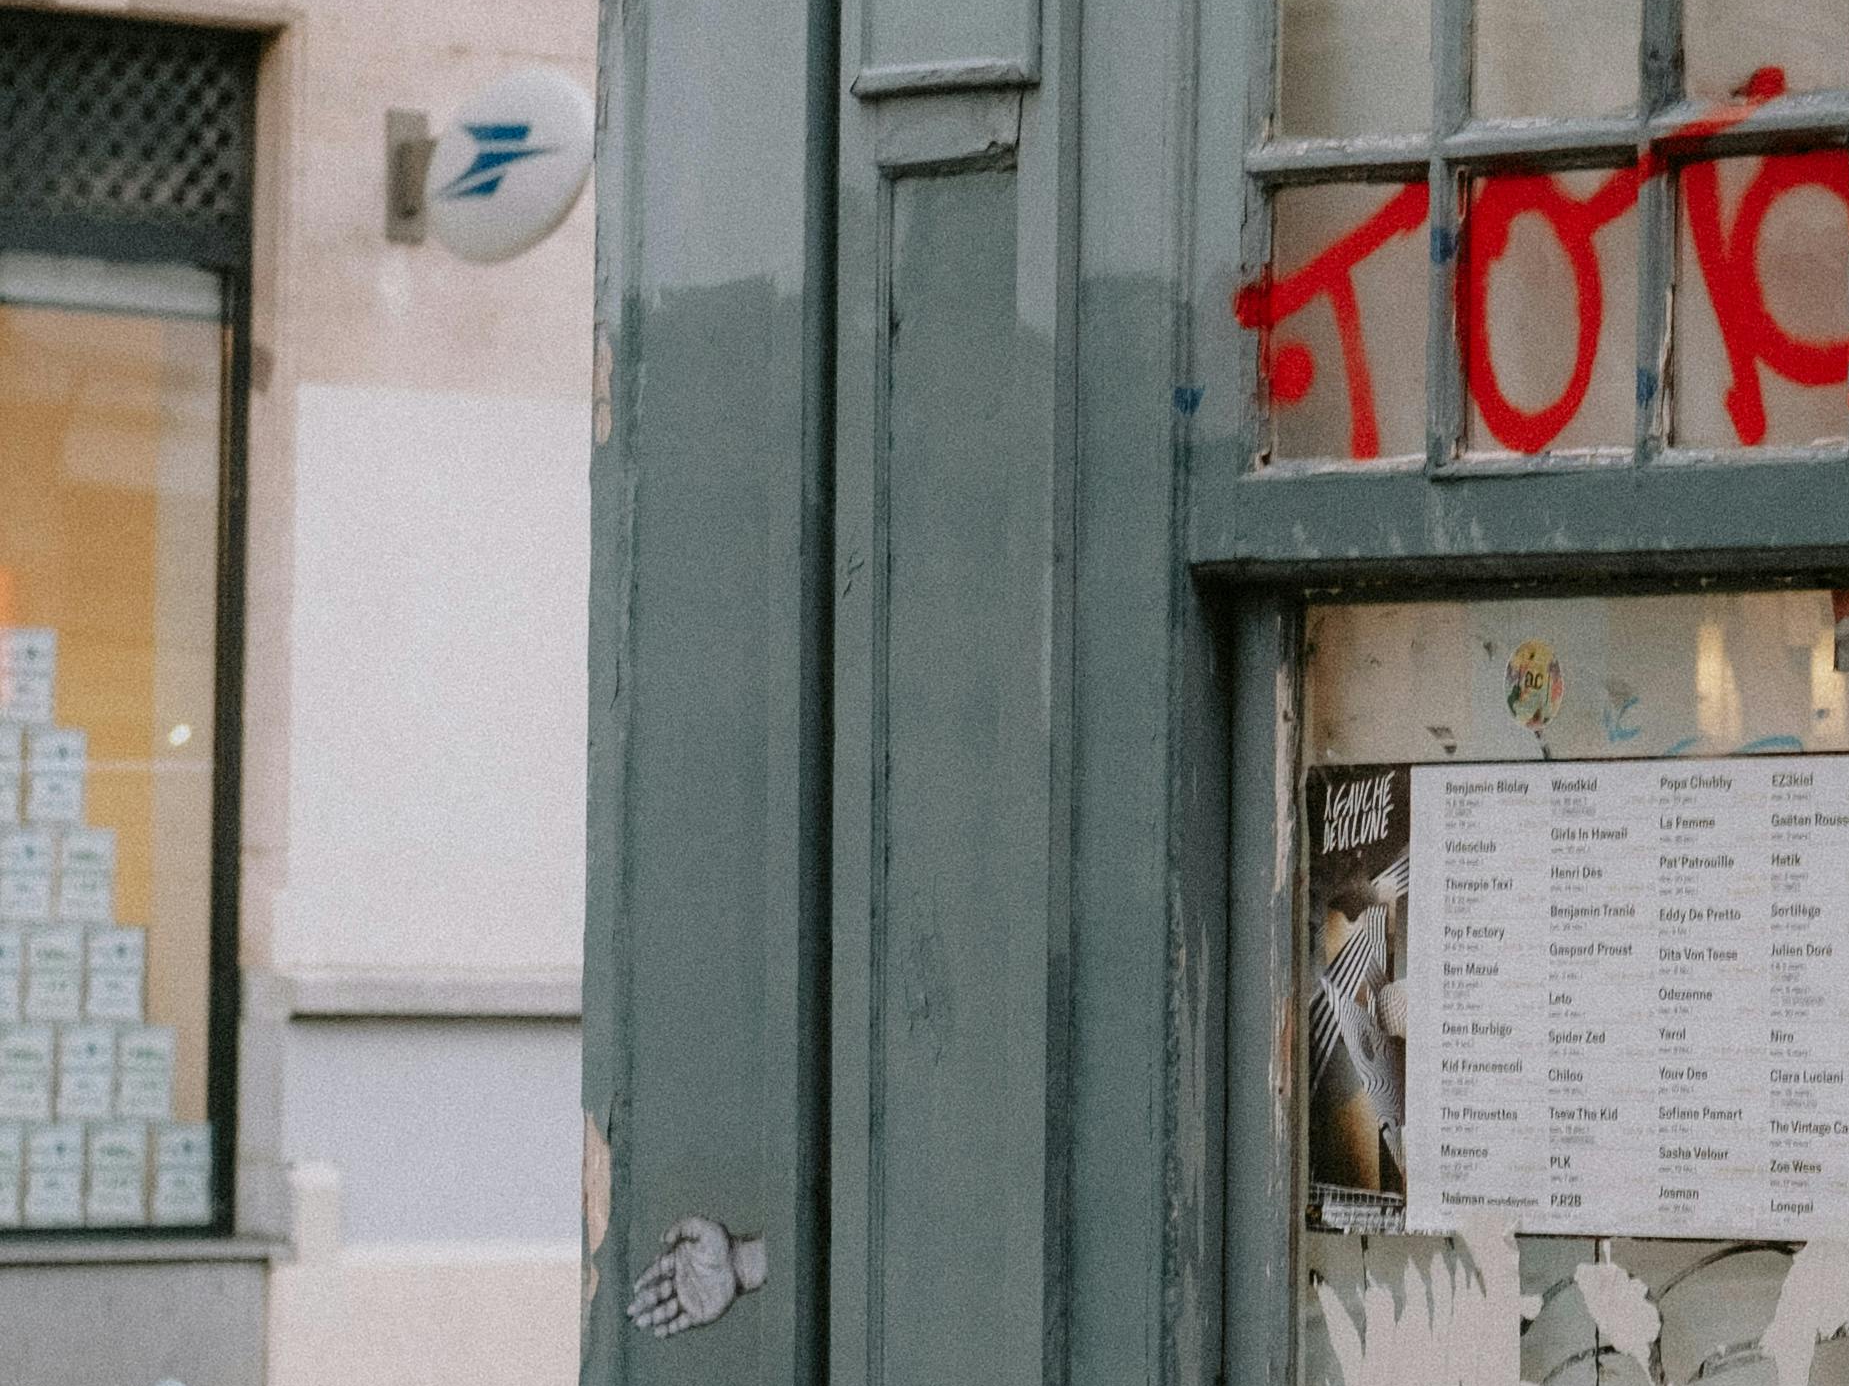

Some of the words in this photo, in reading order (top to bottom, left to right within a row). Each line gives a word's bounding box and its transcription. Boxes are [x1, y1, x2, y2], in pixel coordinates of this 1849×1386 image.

[1333, 770, 1396, 819] GAUCHE
[1690, 776, 1732, 791] Chubby
[1351, 804, 1394, 848] LUNE
[1550, 1156, 1571, 1169] PLK
